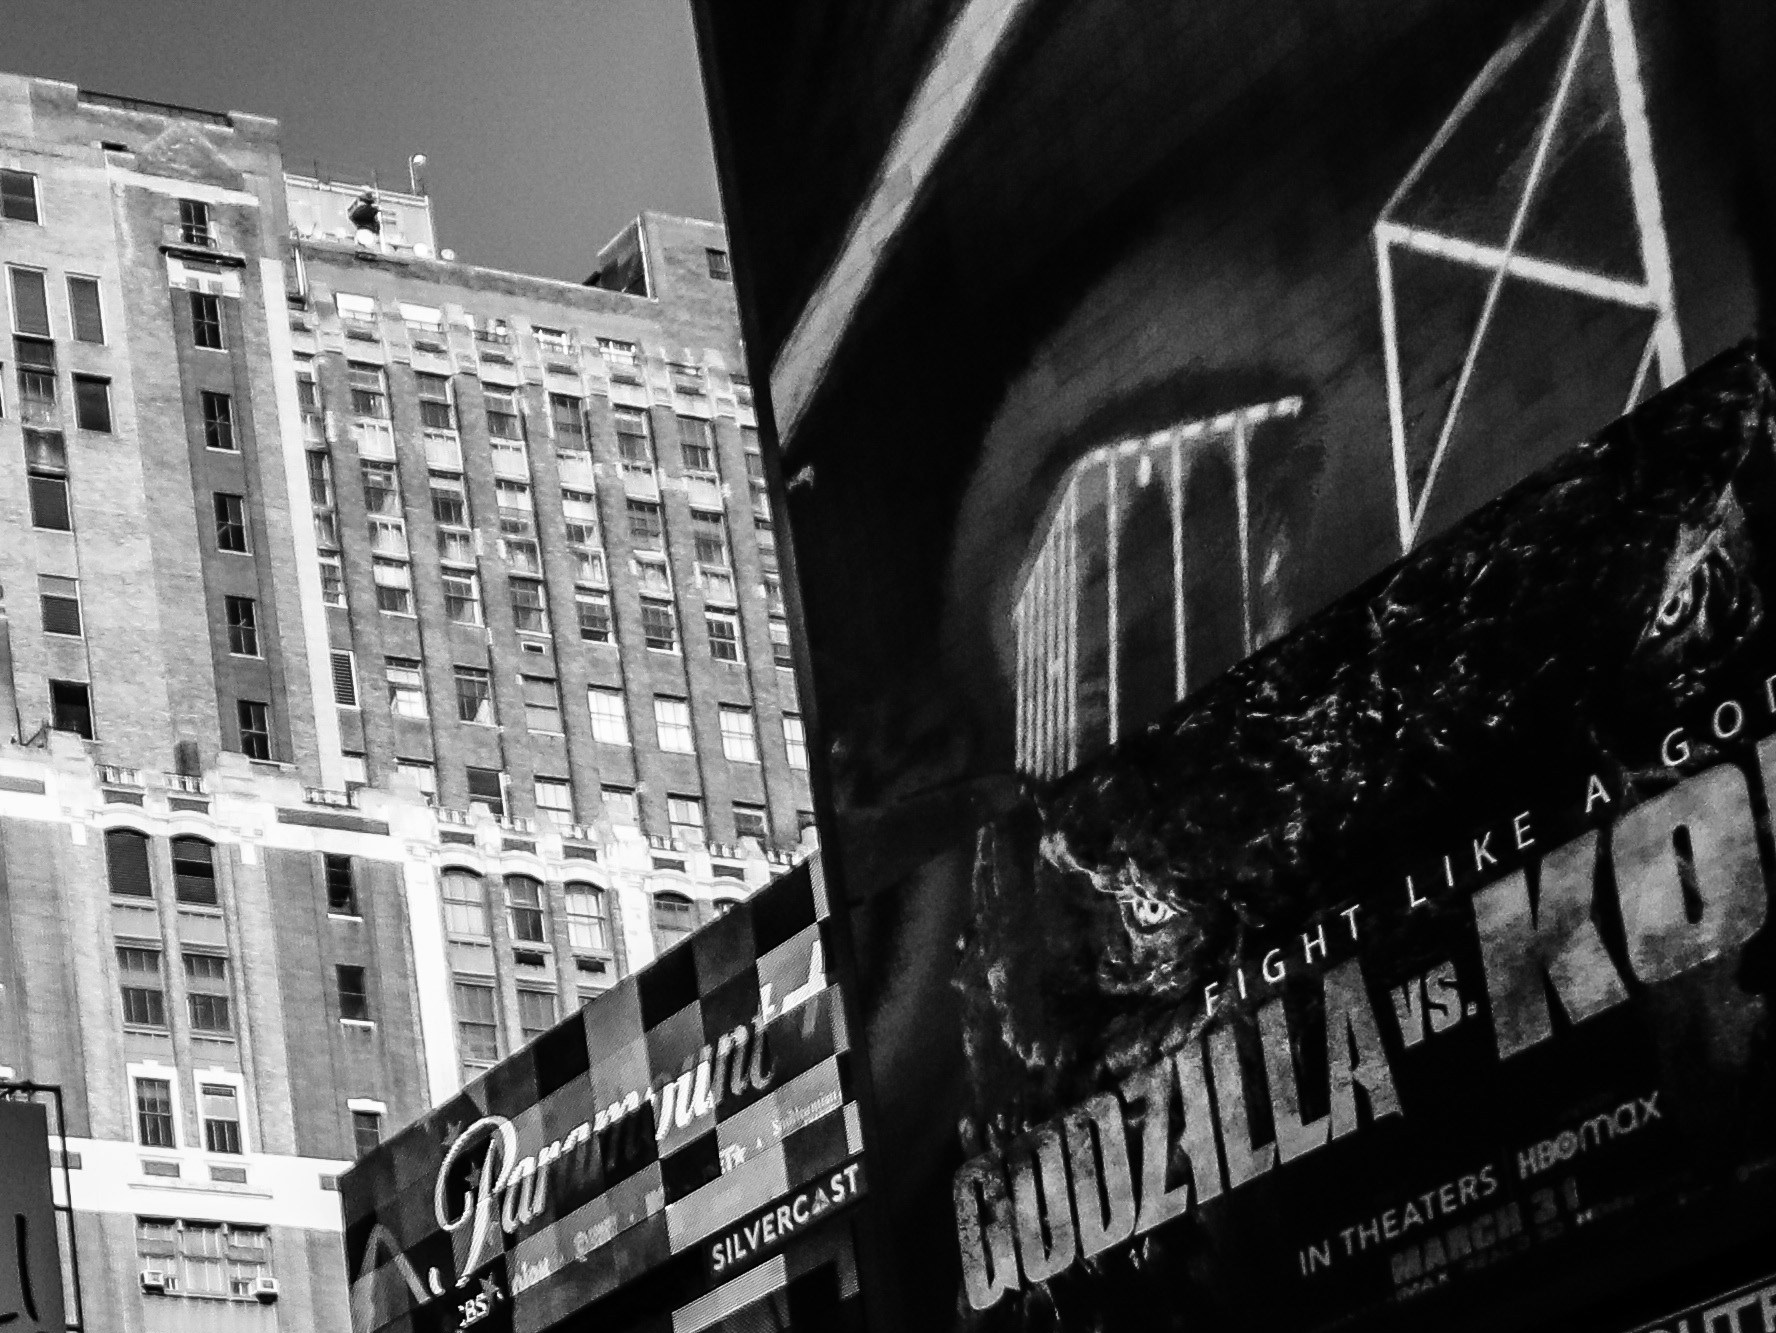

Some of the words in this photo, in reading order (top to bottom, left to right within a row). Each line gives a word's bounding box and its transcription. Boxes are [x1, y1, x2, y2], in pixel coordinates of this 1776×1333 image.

[1205, 903, 1363, 1018] FIGHT
[1405, 810, 1537, 908] LIKE
[1585, 773, 1612, 814] A
[952, 957, 1404, 1310] GODZILLA
[1471, 730, 1776, 1062] KO
[711, 1163, 860, 1272] SILVERCAST
[1298, 1238, 1332, 1278] IN
[1339, 1163, 1498, 1257] THEATERS
